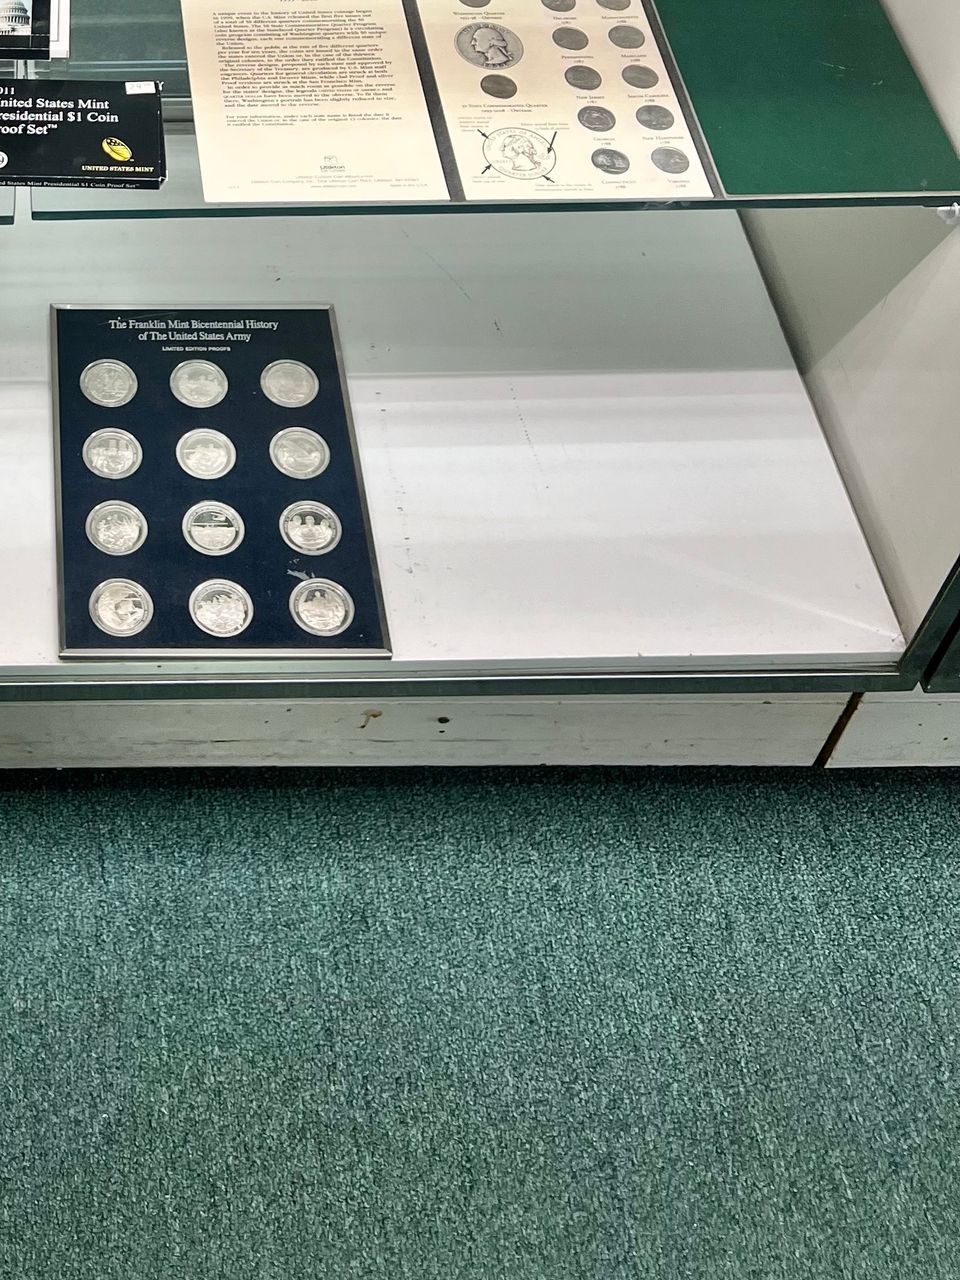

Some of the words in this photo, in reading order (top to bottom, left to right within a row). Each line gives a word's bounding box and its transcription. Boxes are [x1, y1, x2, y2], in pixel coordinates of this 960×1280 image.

[36, 98, 74, 109] States
[77, 98, 109, 109] Mint
[66, 111, 82, 122] $1
[87, 111, 119, 123] Coin
[110, 165, 134, 173] STATES
[109, 320, 127, 329] The
[129, 320, 166, 329] Franklin
[168, 320, 189, 329] Mint
[191, 320, 244, 329] Bicentennial
[246, 320, 279, 331] History
[138, 332, 148, 340] of
[149, 332, 167, 341] The
[169, 332, 198, 341] United
[199, 332, 224, 341] States
[226, 332, 251, 342] Army
